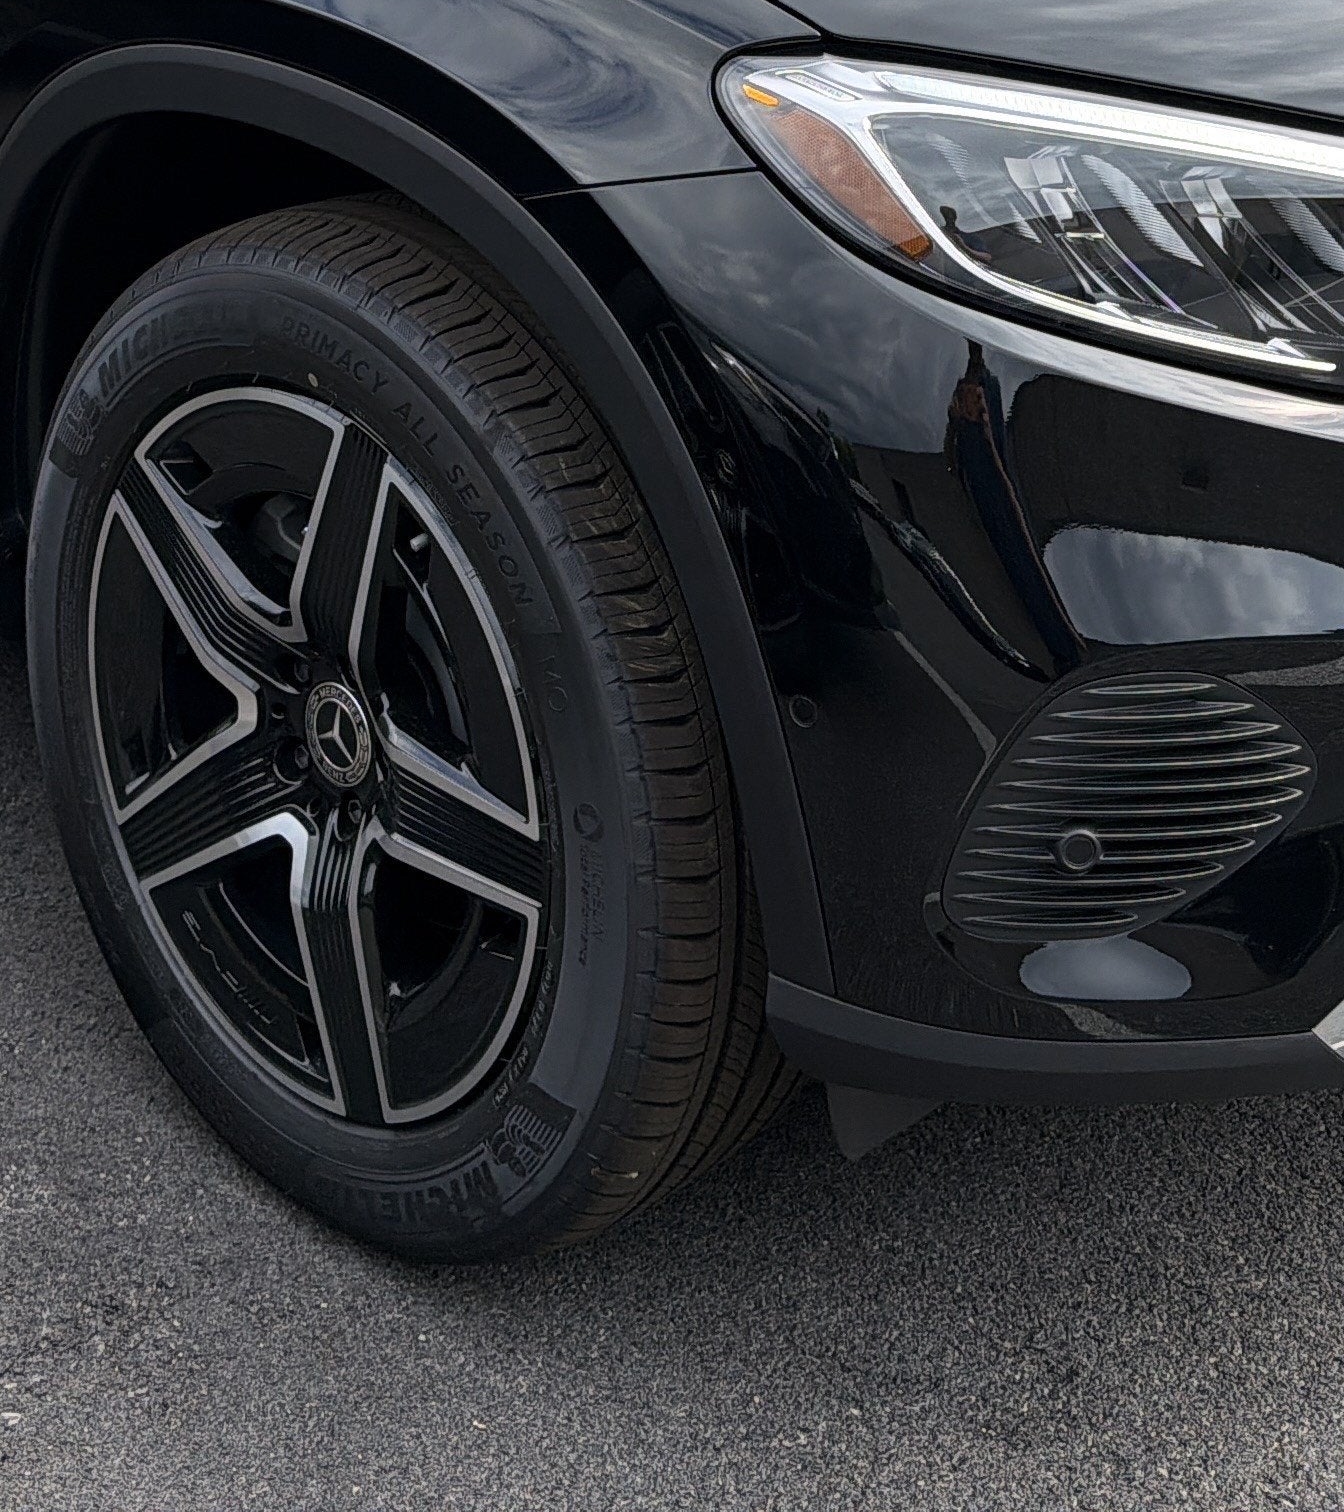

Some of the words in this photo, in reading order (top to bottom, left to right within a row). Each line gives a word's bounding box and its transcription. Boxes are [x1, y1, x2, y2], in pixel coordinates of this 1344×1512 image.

[279, 315, 388, 395] PRIMACY
[393, 401, 438, 459] ALL
[445, 464, 535, 607] SEASON
